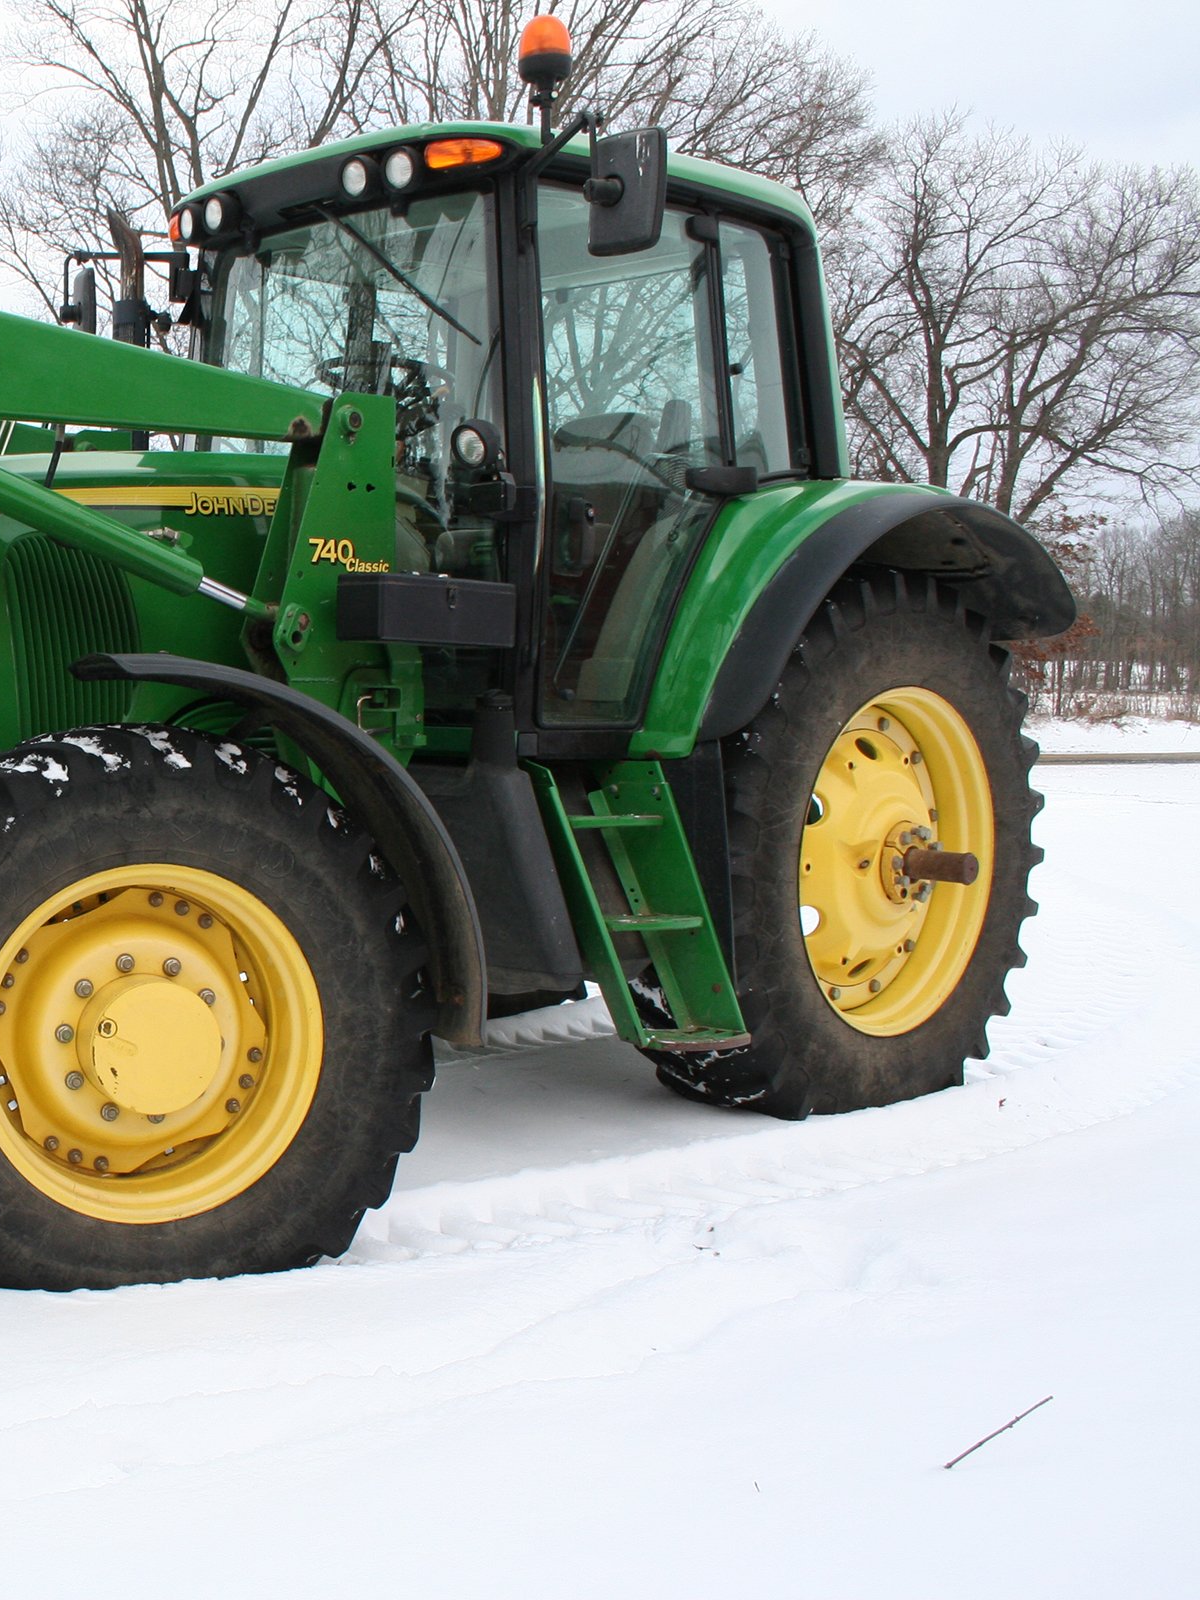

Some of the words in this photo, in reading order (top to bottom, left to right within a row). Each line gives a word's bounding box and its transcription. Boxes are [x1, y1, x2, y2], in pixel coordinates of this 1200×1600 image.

[184, 492, 244, 516] JOHN
[308, 537, 354, 565] 740
[346, 558, 390, 573] Classic
